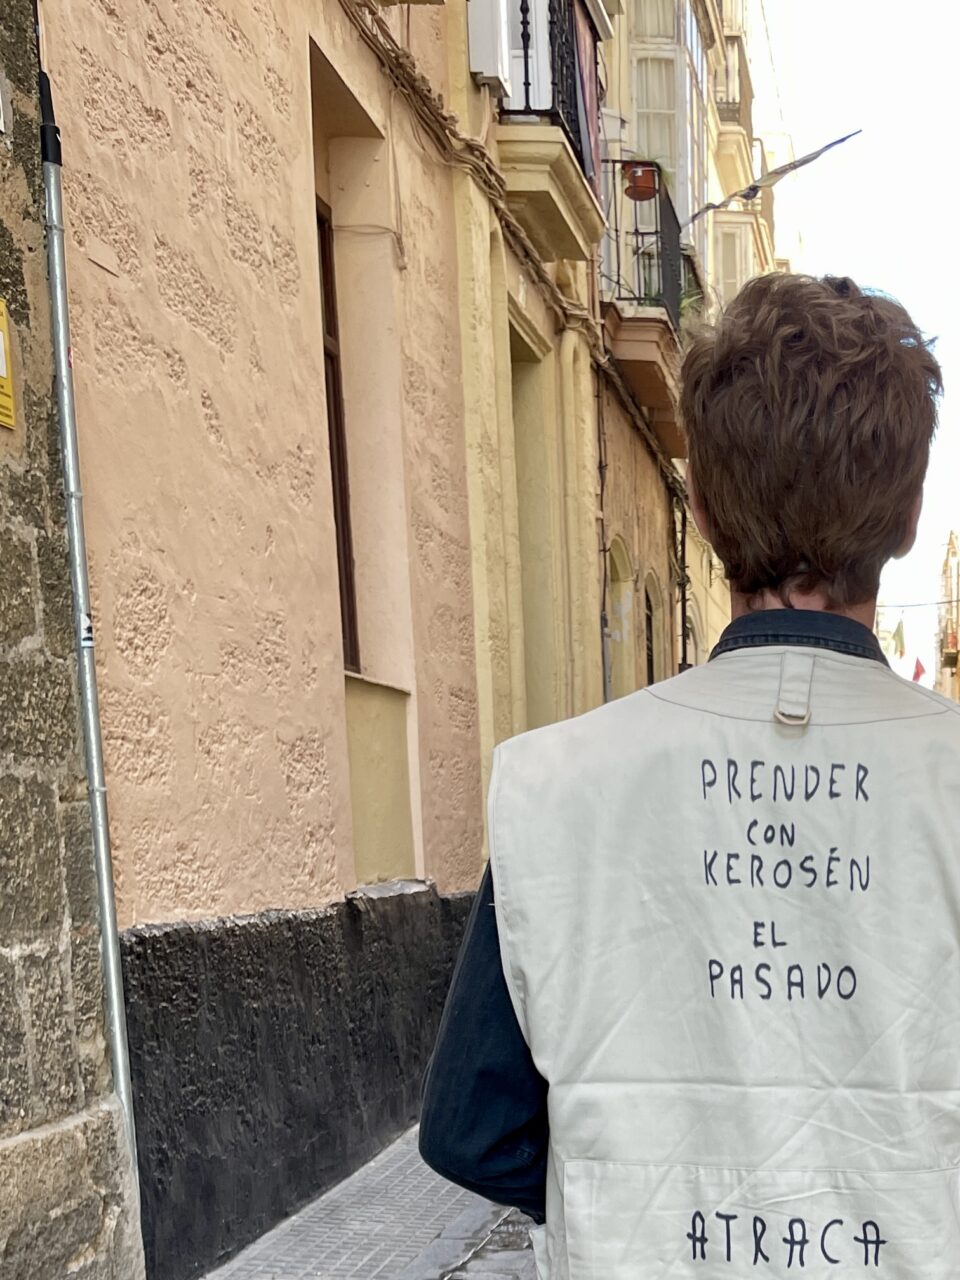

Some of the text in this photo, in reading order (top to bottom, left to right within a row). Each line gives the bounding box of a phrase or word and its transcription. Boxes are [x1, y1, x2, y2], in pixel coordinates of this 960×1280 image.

[702, 759, 870, 804] PRENDER
[746, 819, 796, 847] CON
[703, 847, 870, 892] KEROSÉN
[753, 921, 788, 948] EL
[708, 959, 857, 1001] PASADO
[686, 1210, 889, 1269] ATRACA
